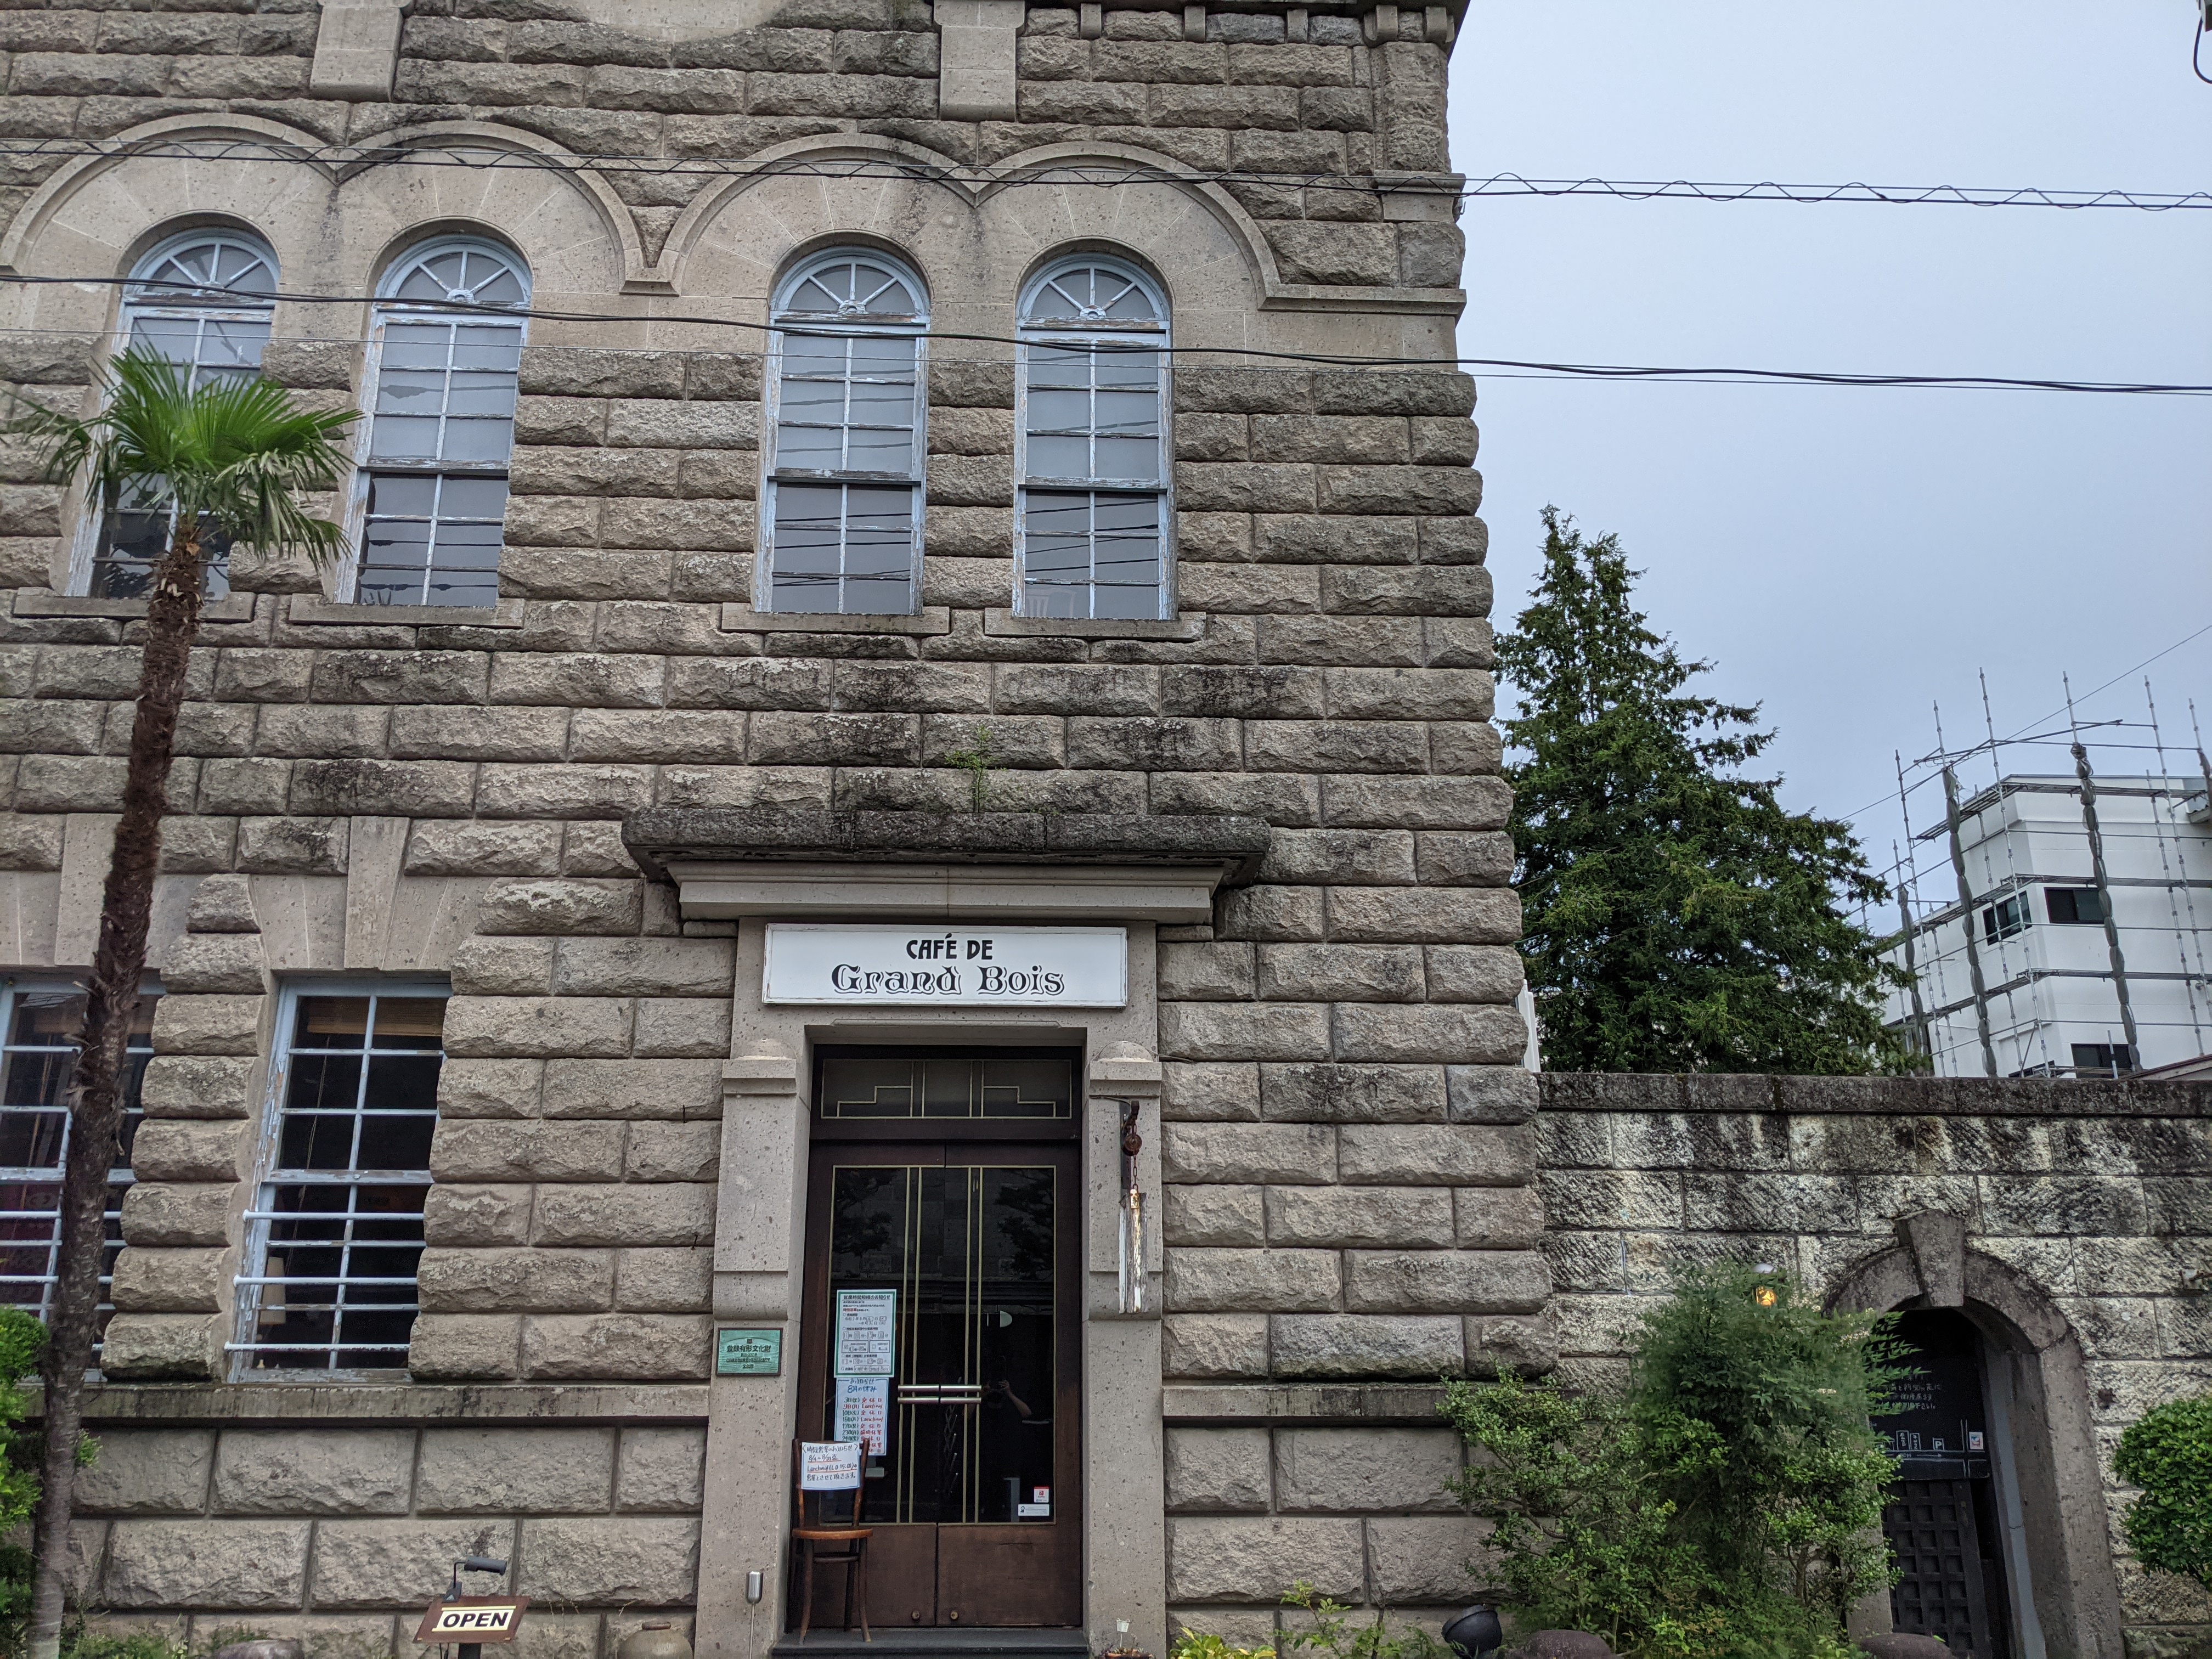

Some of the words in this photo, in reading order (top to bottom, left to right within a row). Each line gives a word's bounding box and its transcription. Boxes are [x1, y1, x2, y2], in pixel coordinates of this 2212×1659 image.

[906, 933, 957, 960] CAFÉ
[966, 940, 994, 960] DE
[831, 964, 962, 996] Grand
[977, 964, 1065, 996] Bois
[847, 1385, 877, 1393] 8月の休み
[1935, 1440, 1942, 1449] P
[443, 1612, 510, 1628] OPEN
